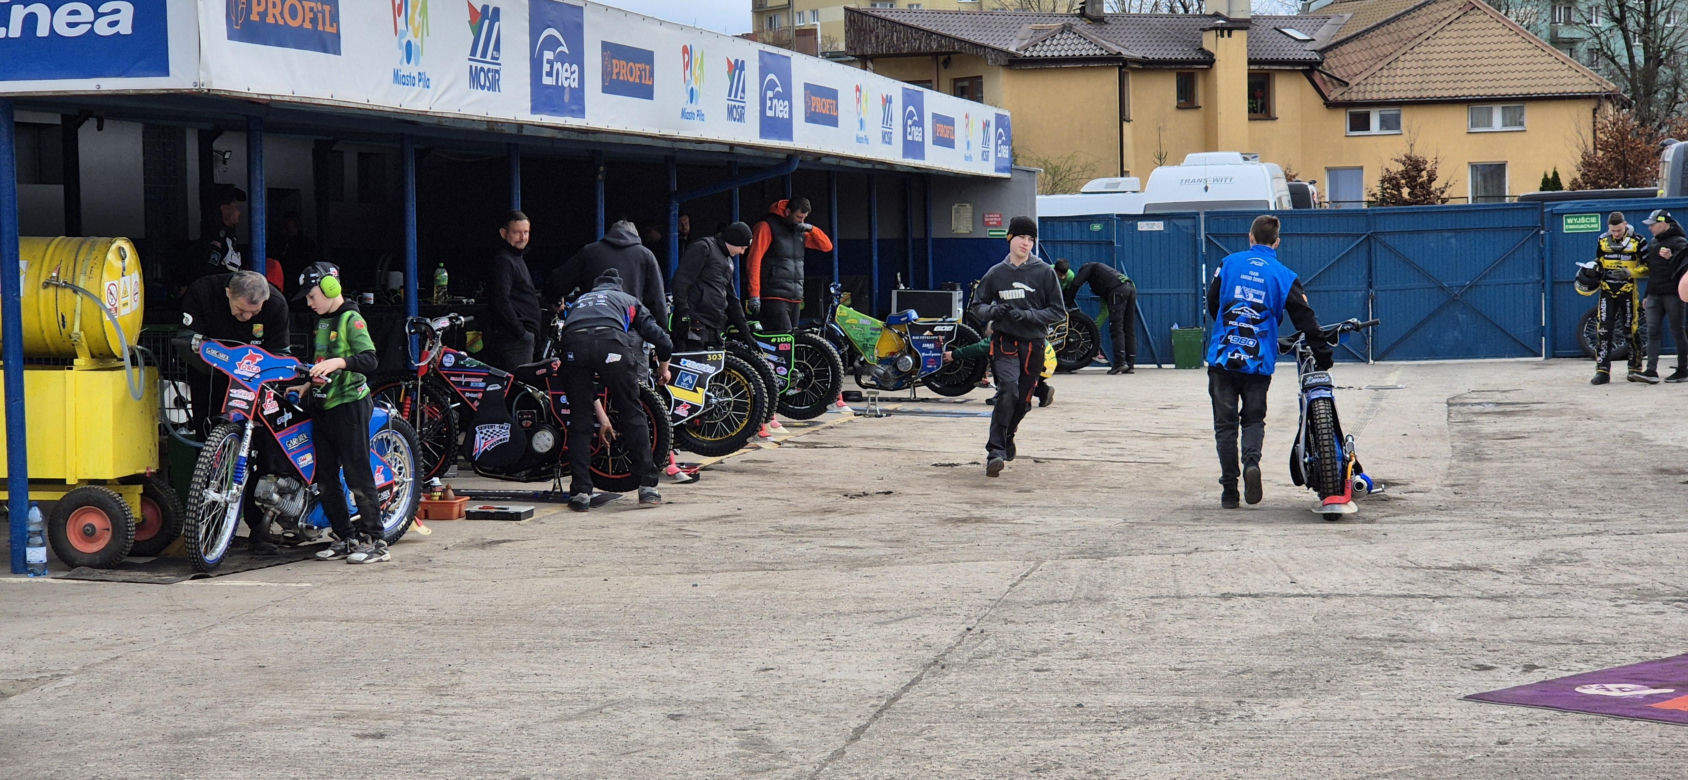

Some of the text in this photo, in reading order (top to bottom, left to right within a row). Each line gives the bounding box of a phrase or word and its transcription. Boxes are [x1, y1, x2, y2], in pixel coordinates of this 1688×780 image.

[0, 0, 135, 38] nea
[393, 68, 416, 88] Miasto
[541, 50, 579, 89] Enea
[766, 90, 790, 119] Enea
[907, 119, 923, 142] Enea
[707, 353, 723, 361] 303
